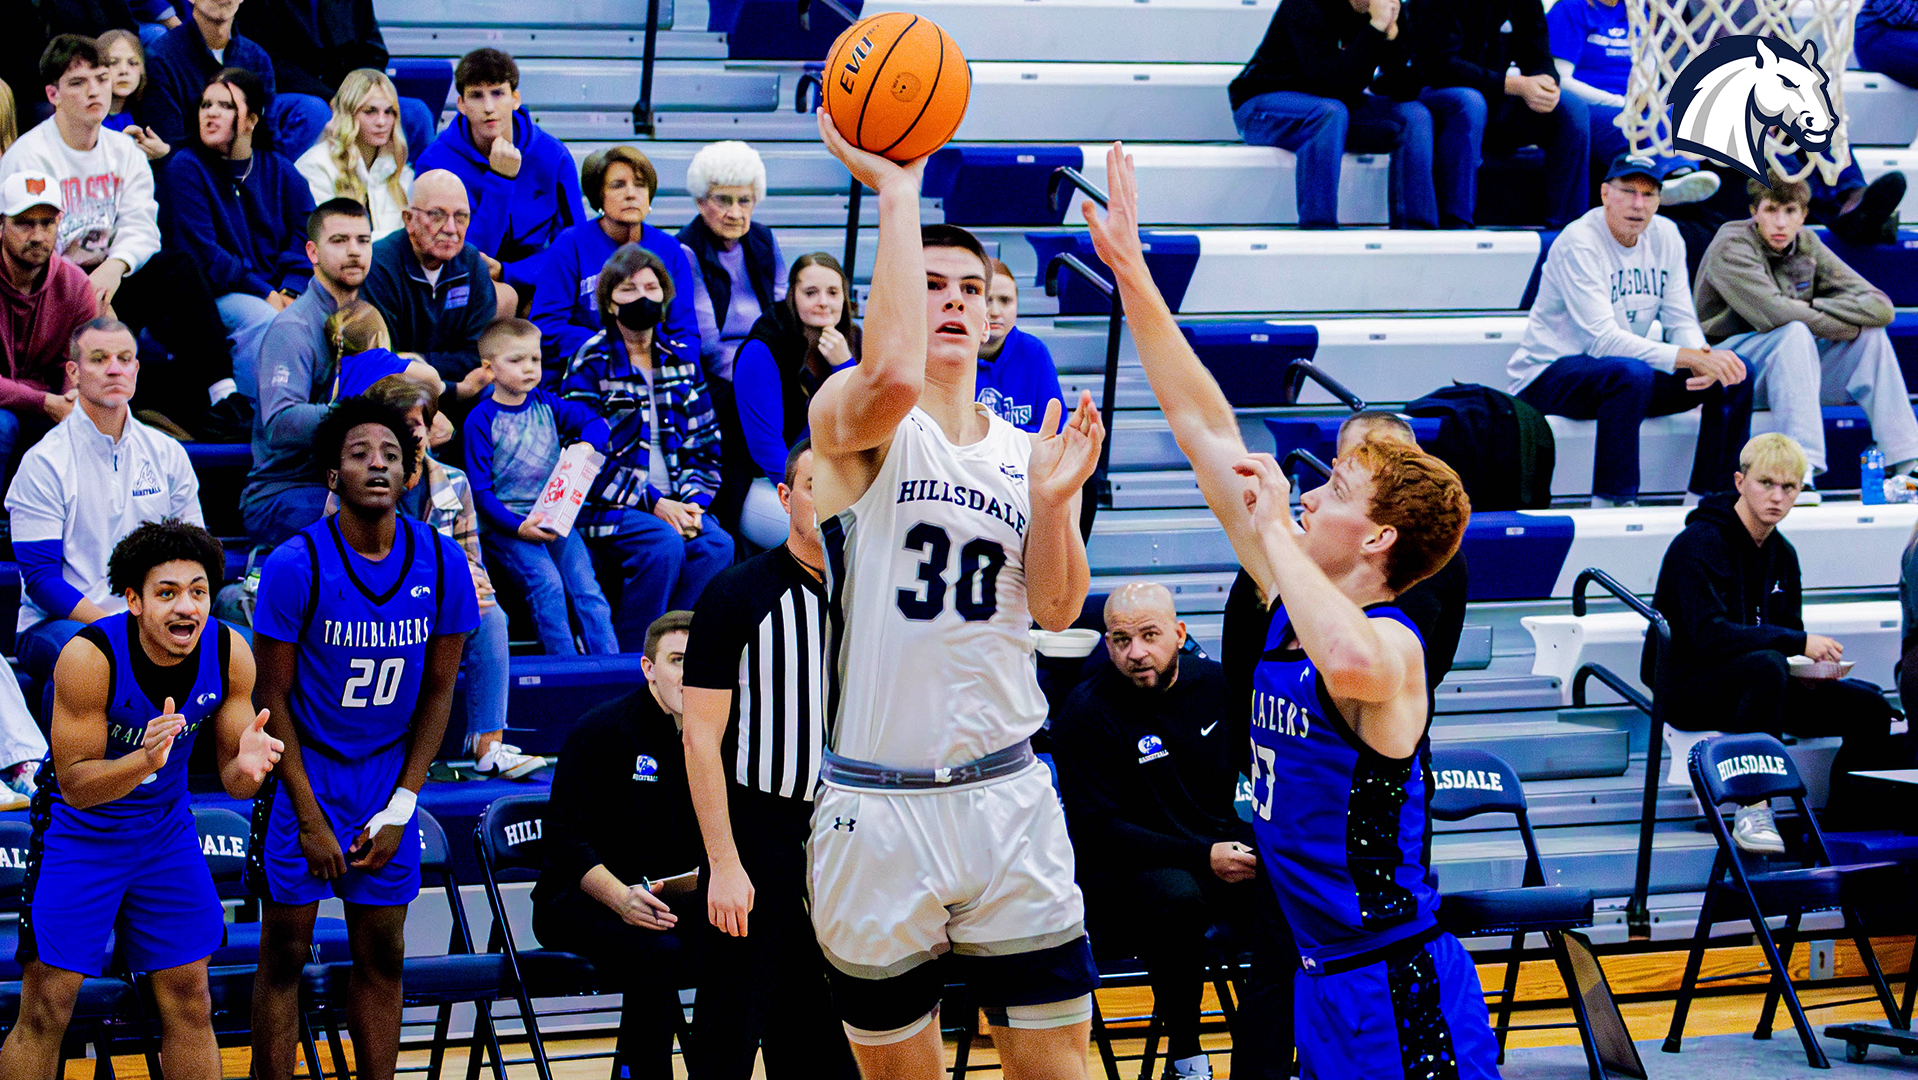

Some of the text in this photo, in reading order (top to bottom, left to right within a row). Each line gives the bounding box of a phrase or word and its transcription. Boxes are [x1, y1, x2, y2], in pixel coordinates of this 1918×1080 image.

[897, 479, 1026, 538] HILLSDALE
[895, 519, 1007, 623] 30
[324, 616, 429, 647] TRAILBLAZERS
[341, 657, 405, 708] 20
[1716, 754, 1788, 782] HILLSDALE
